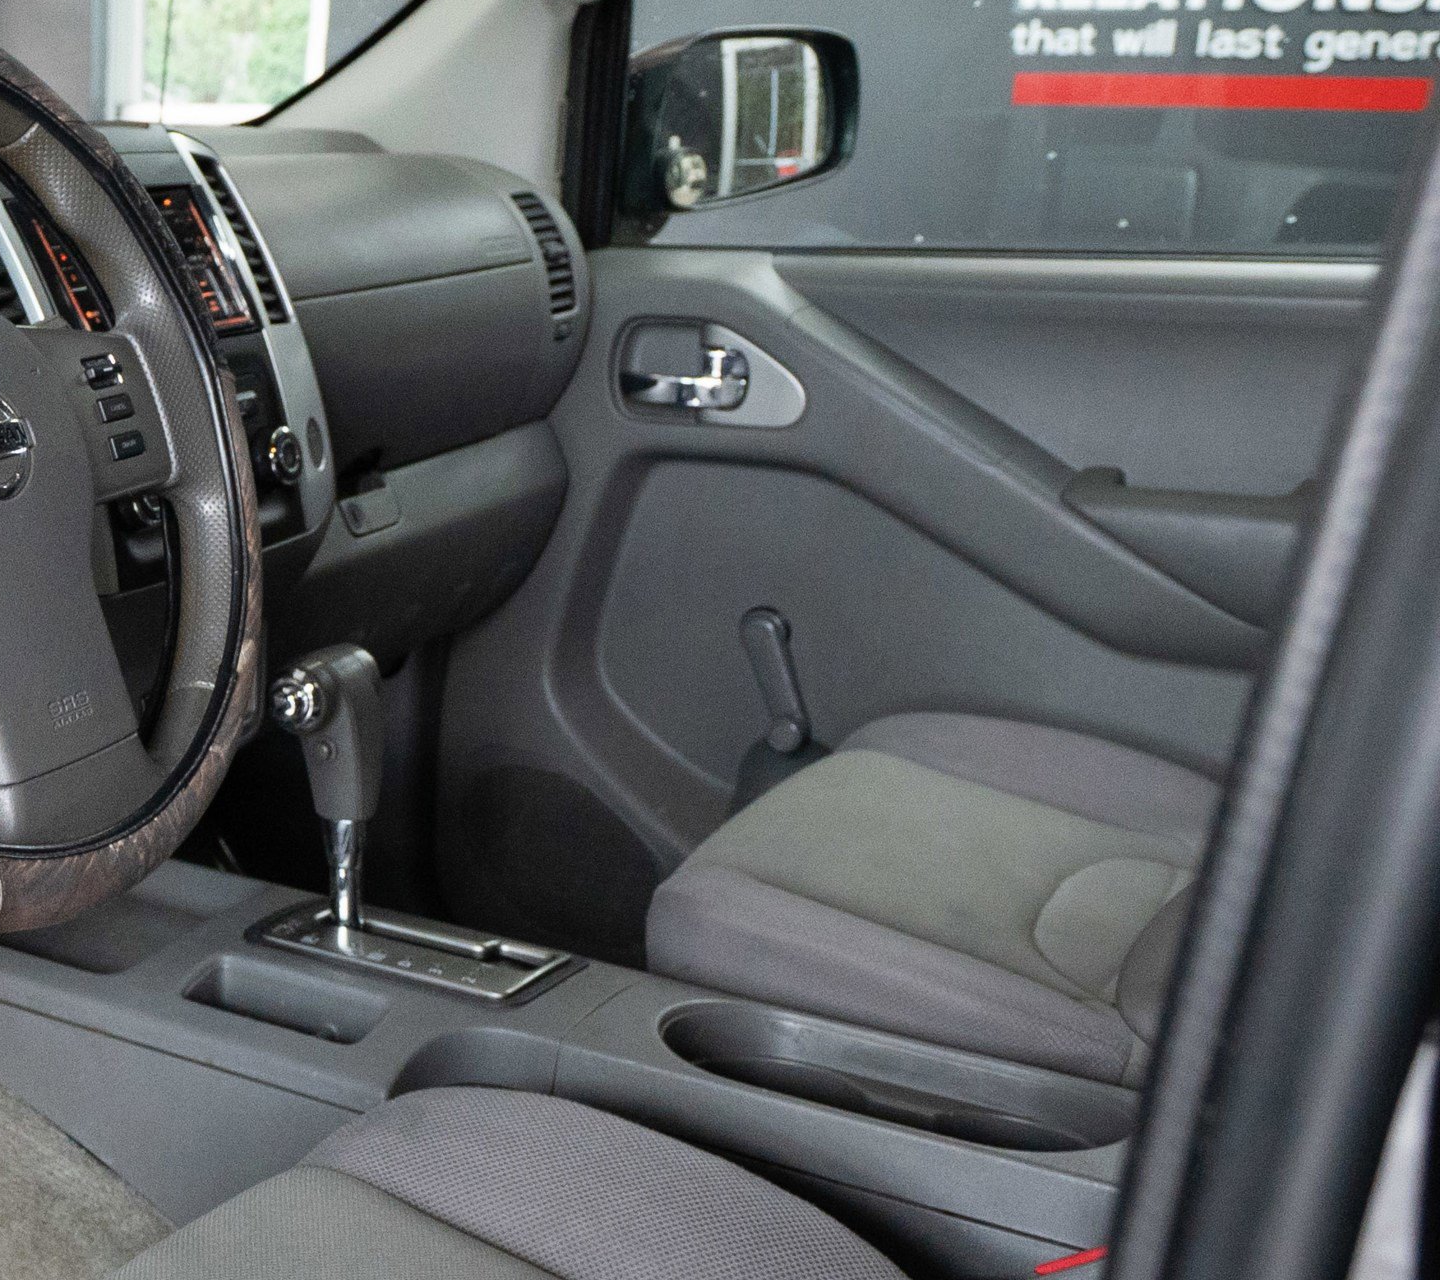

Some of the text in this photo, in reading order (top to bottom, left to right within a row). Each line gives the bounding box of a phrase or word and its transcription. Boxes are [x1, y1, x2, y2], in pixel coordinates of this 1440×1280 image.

[1012, 21, 1097, 57] that
[1113, 20, 1179, 57] will
[1196, 20, 1284, 59] last
[49, 691, 89, 717] SRS
